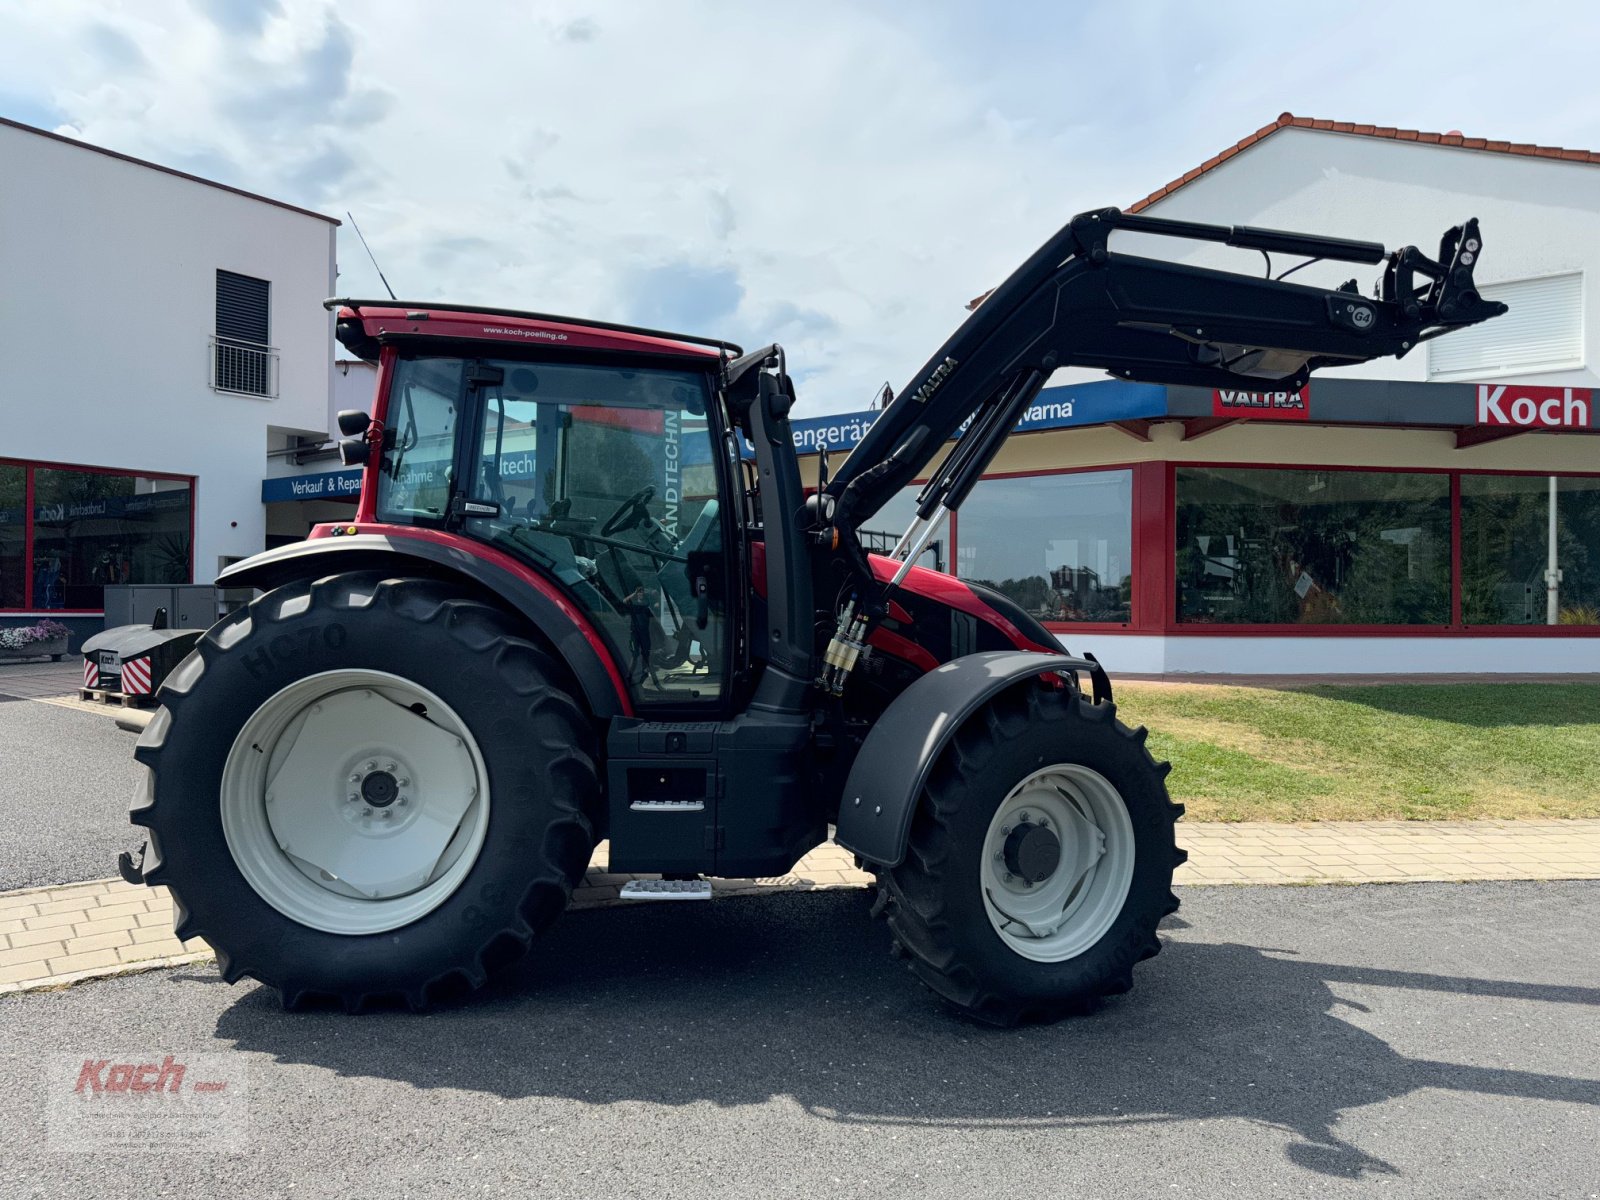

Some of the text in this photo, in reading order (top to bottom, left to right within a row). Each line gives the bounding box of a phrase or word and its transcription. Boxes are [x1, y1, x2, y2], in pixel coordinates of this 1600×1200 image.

[1354, 311, 1370, 323] G4
[483, 326, 569, 341] www.koch-poelling.de
[911, 356, 959, 404] VALTRA
[1218, 390, 1305, 409] VALTRA
[1478, 384, 1588, 426] Koch
[1018, 402, 1073, 425] varna
[291, 478, 324, 495] Verkauf
[327, 477, 335, 492] &
